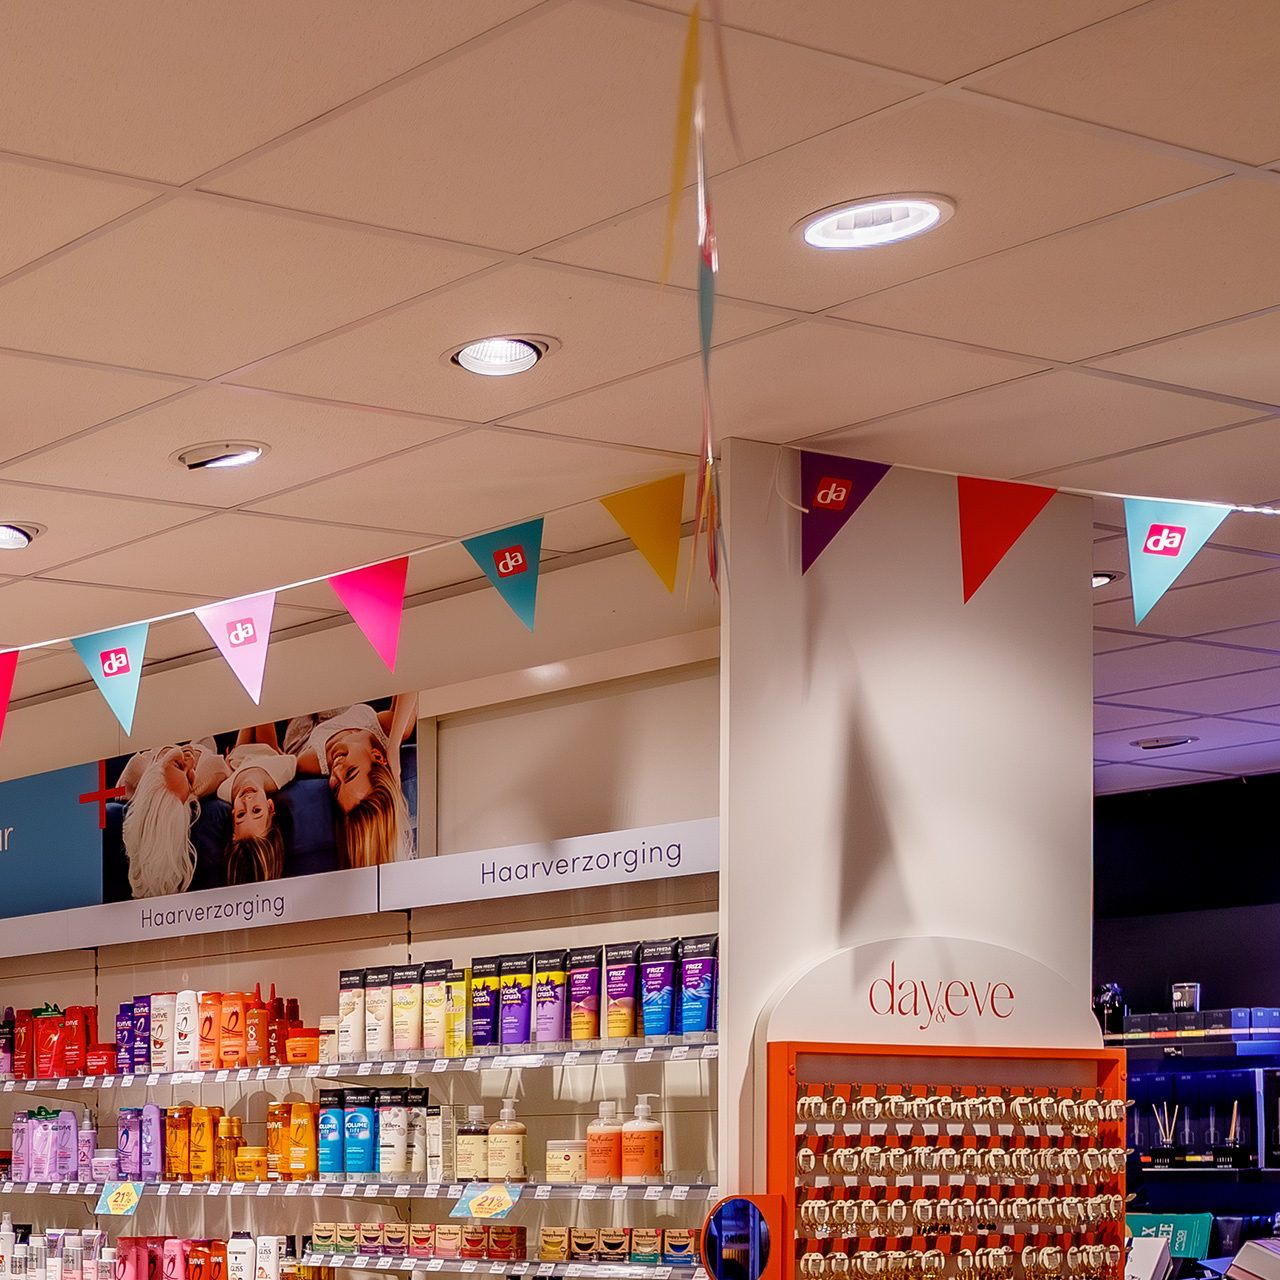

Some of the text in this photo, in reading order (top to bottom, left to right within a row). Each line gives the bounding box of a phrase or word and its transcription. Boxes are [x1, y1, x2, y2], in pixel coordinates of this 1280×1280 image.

[480, 839, 683, 885] Haarverzorging
[140, 893, 285, 929] Haarverzorging
[113, 1192, 132, 1204] 21%
[476, 1195, 505, 1208] 21%
